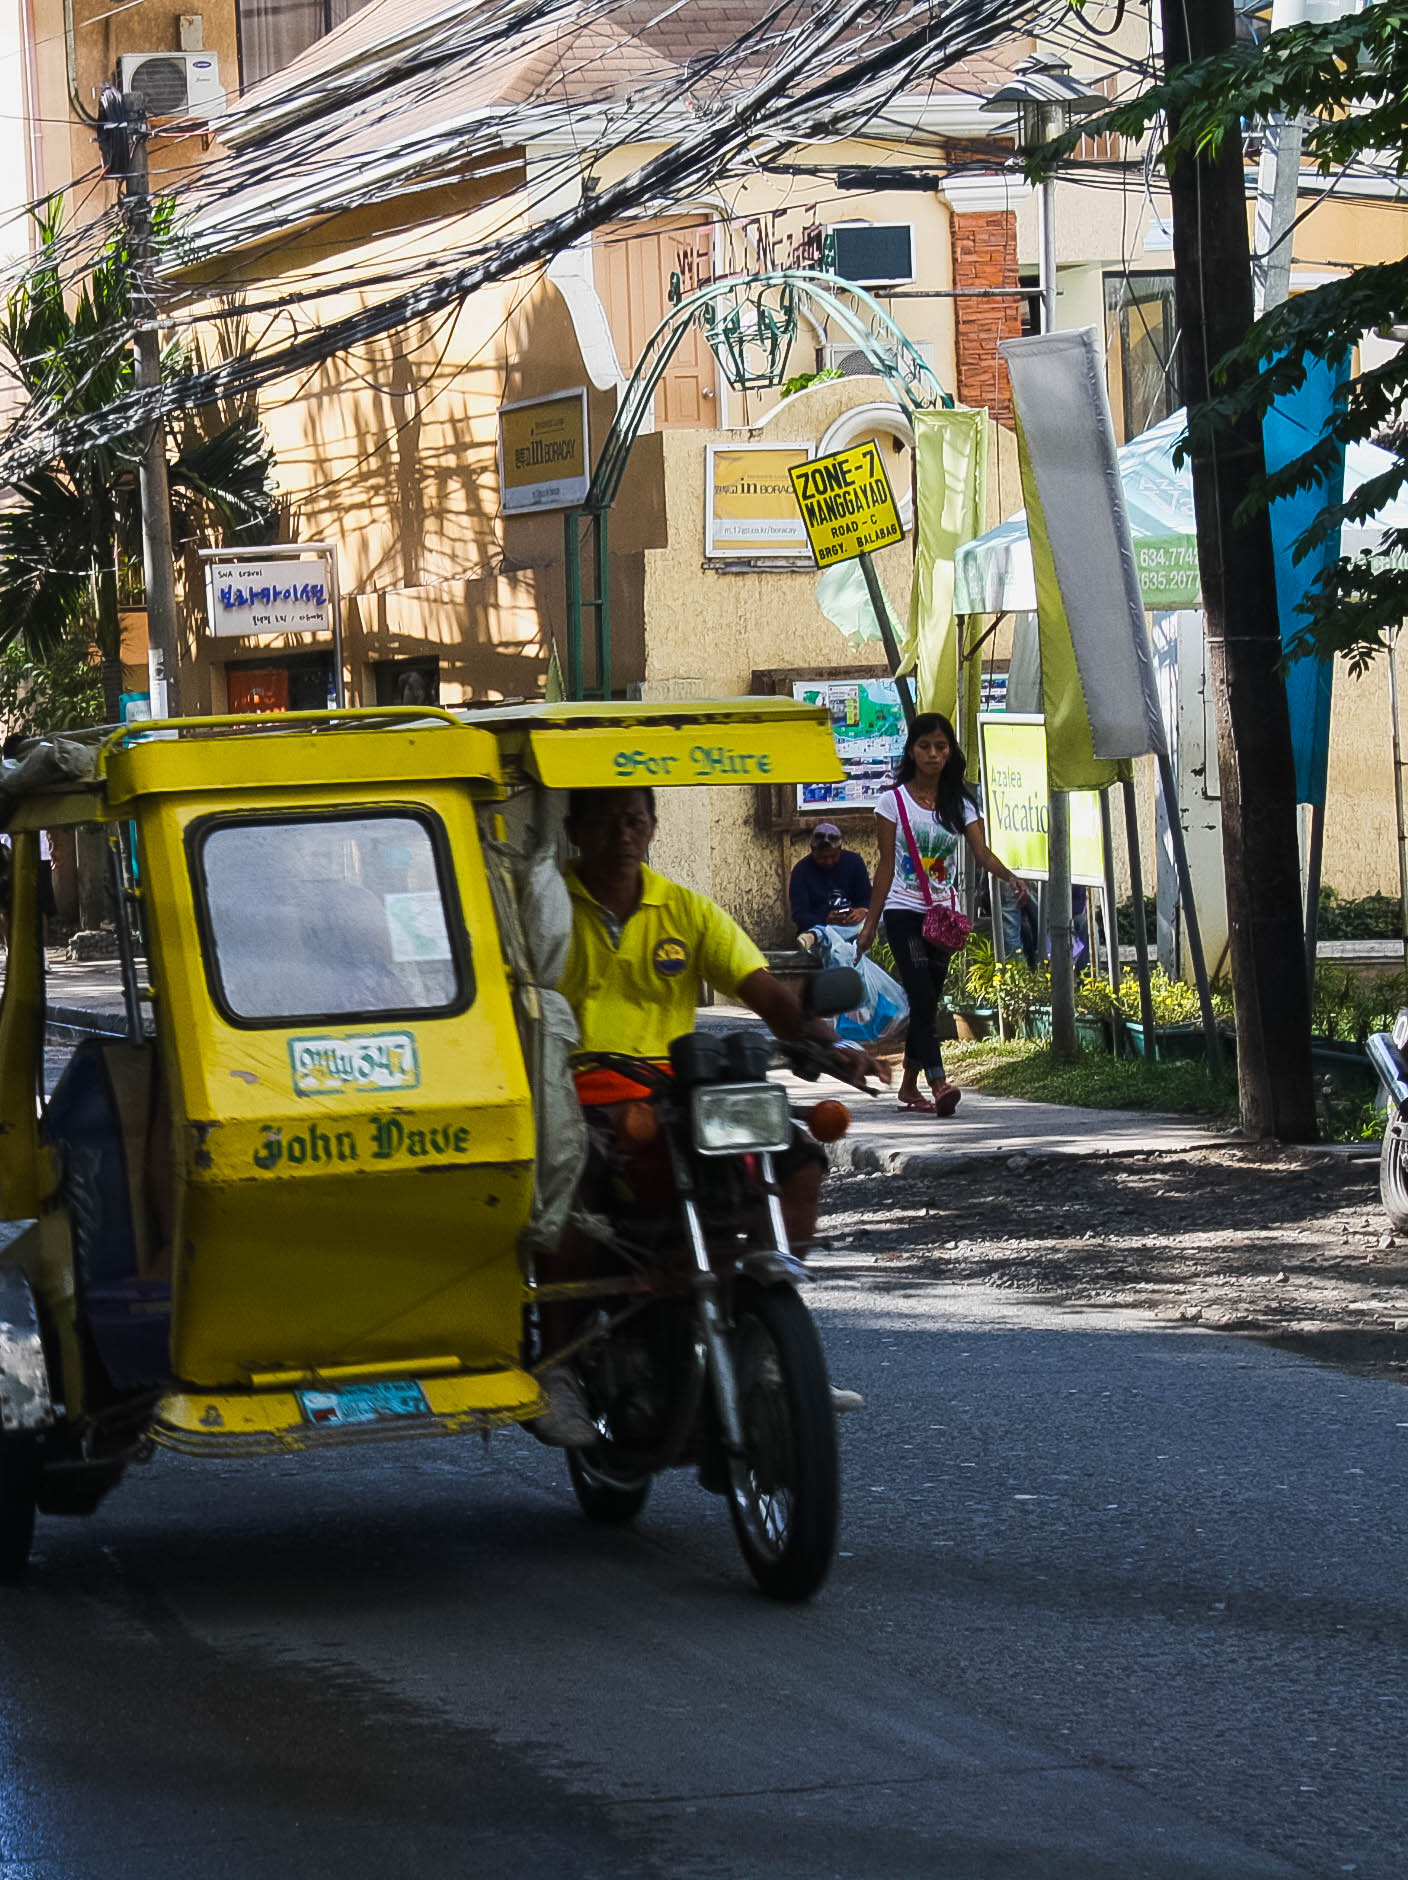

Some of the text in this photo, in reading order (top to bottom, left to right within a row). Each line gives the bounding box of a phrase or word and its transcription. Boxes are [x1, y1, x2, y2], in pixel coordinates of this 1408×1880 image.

[544, 439, 576, 463] BORACAY
[740, 477, 758, 494] in
[760, 485, 795, 494] BORAC
[795, 449, 876, 501] ZONE-7
[804, 478, 889, 529] MANGGAYAD
[818, 523, 898, 560] BRGY. BALABAG
[831, 521, 859, 539] ROAD
[613, 745, 773, 777] For Hire
[991, 764, 1023, 788] Azalea
[992, 789, 1049, 834] Vacatio
[253, 1116, 471, 1170] John Dave
